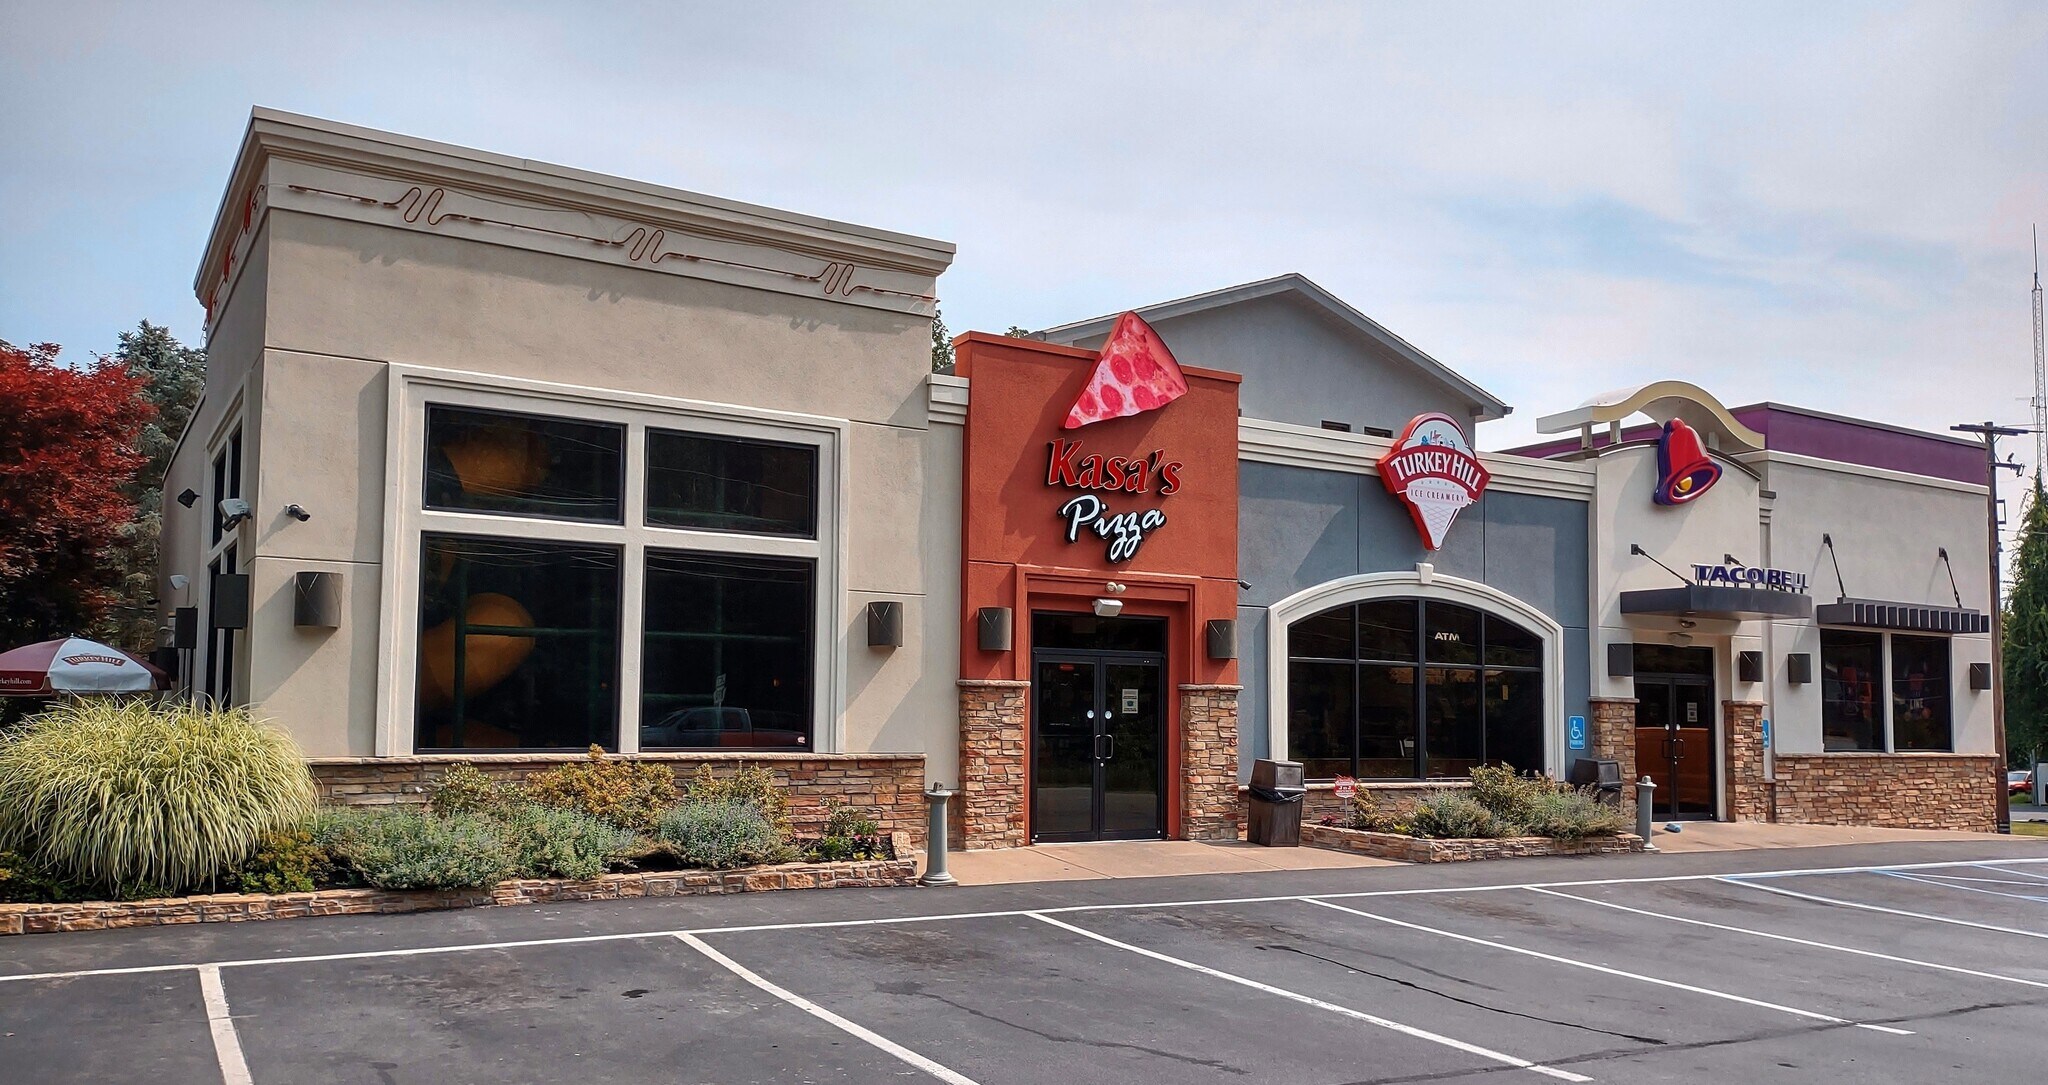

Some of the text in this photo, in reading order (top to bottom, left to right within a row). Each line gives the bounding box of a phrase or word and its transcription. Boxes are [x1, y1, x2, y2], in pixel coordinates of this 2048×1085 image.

[1048, 438, 1183, 494] Kasa's
[1390, 451, 1482, 492] TURKEY HILL
[1411, 489, 1464, 502] ICE CREAMERY
[1062, 494, 1165, 561] Pizza
[1690, 564, 1809, 589] TACO BELL
[1434, 631, 1460, 642] ATM
[65, 654, 121, 665] TURKEY HILL
